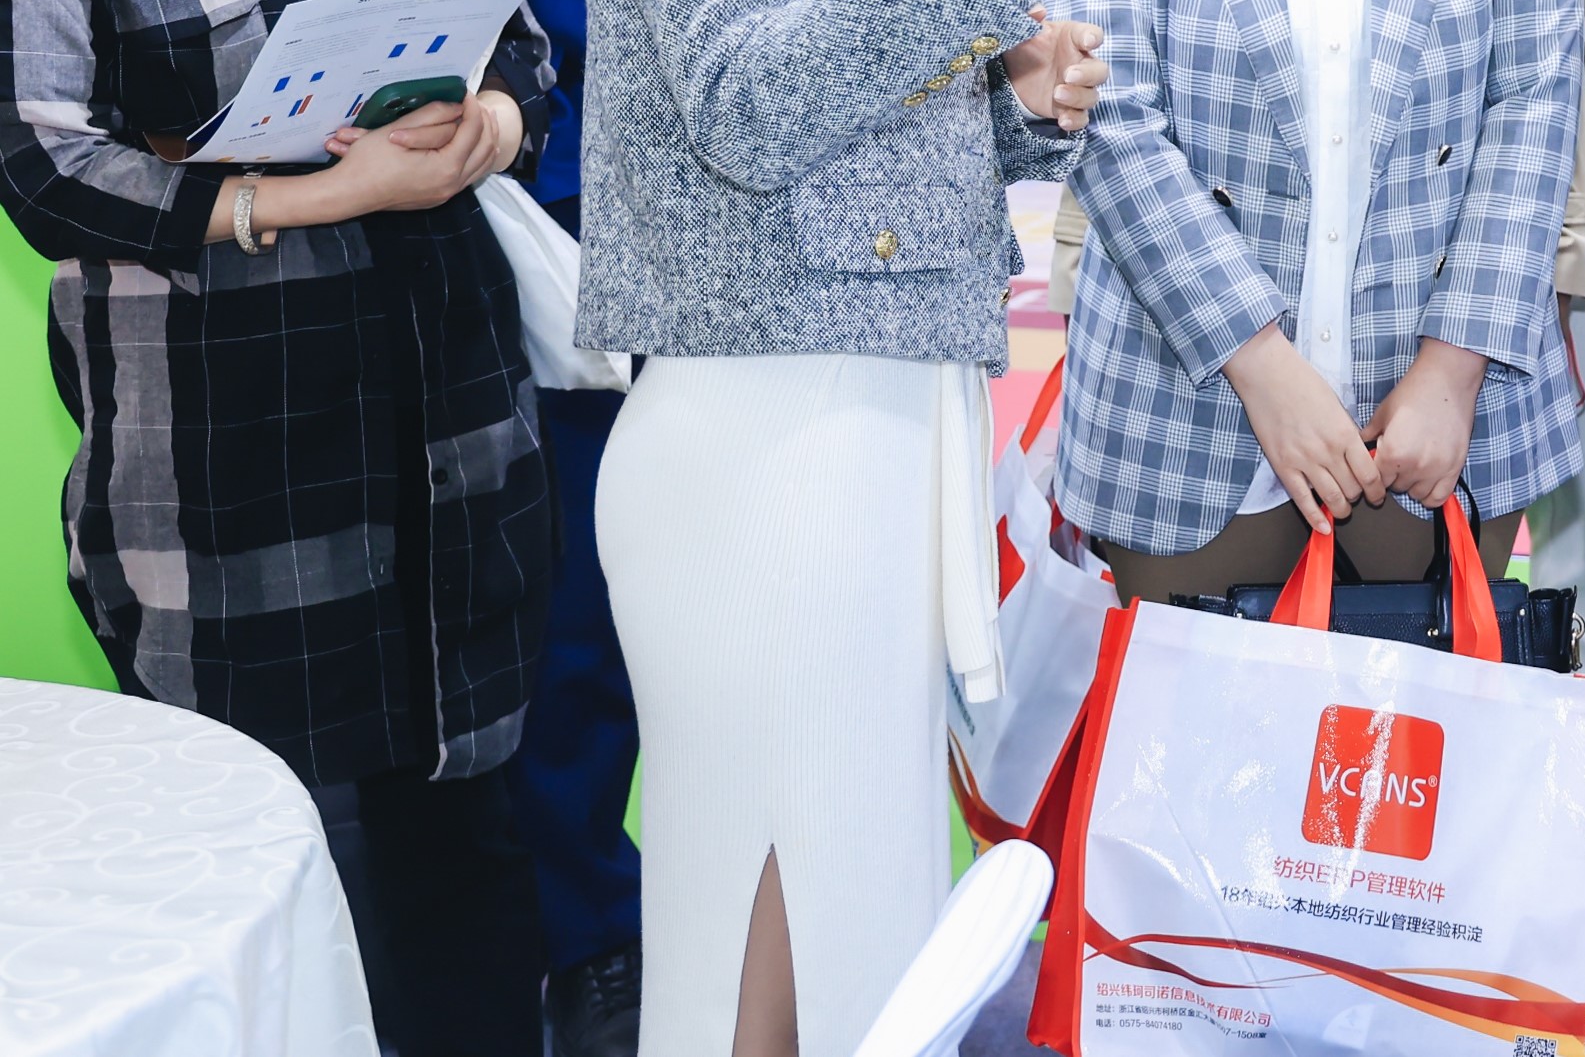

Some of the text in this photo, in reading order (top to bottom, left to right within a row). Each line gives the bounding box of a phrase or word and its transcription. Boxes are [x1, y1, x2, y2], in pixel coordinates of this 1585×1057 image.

[1274, 855, 1446, 904] 纺织ERP管理软件
